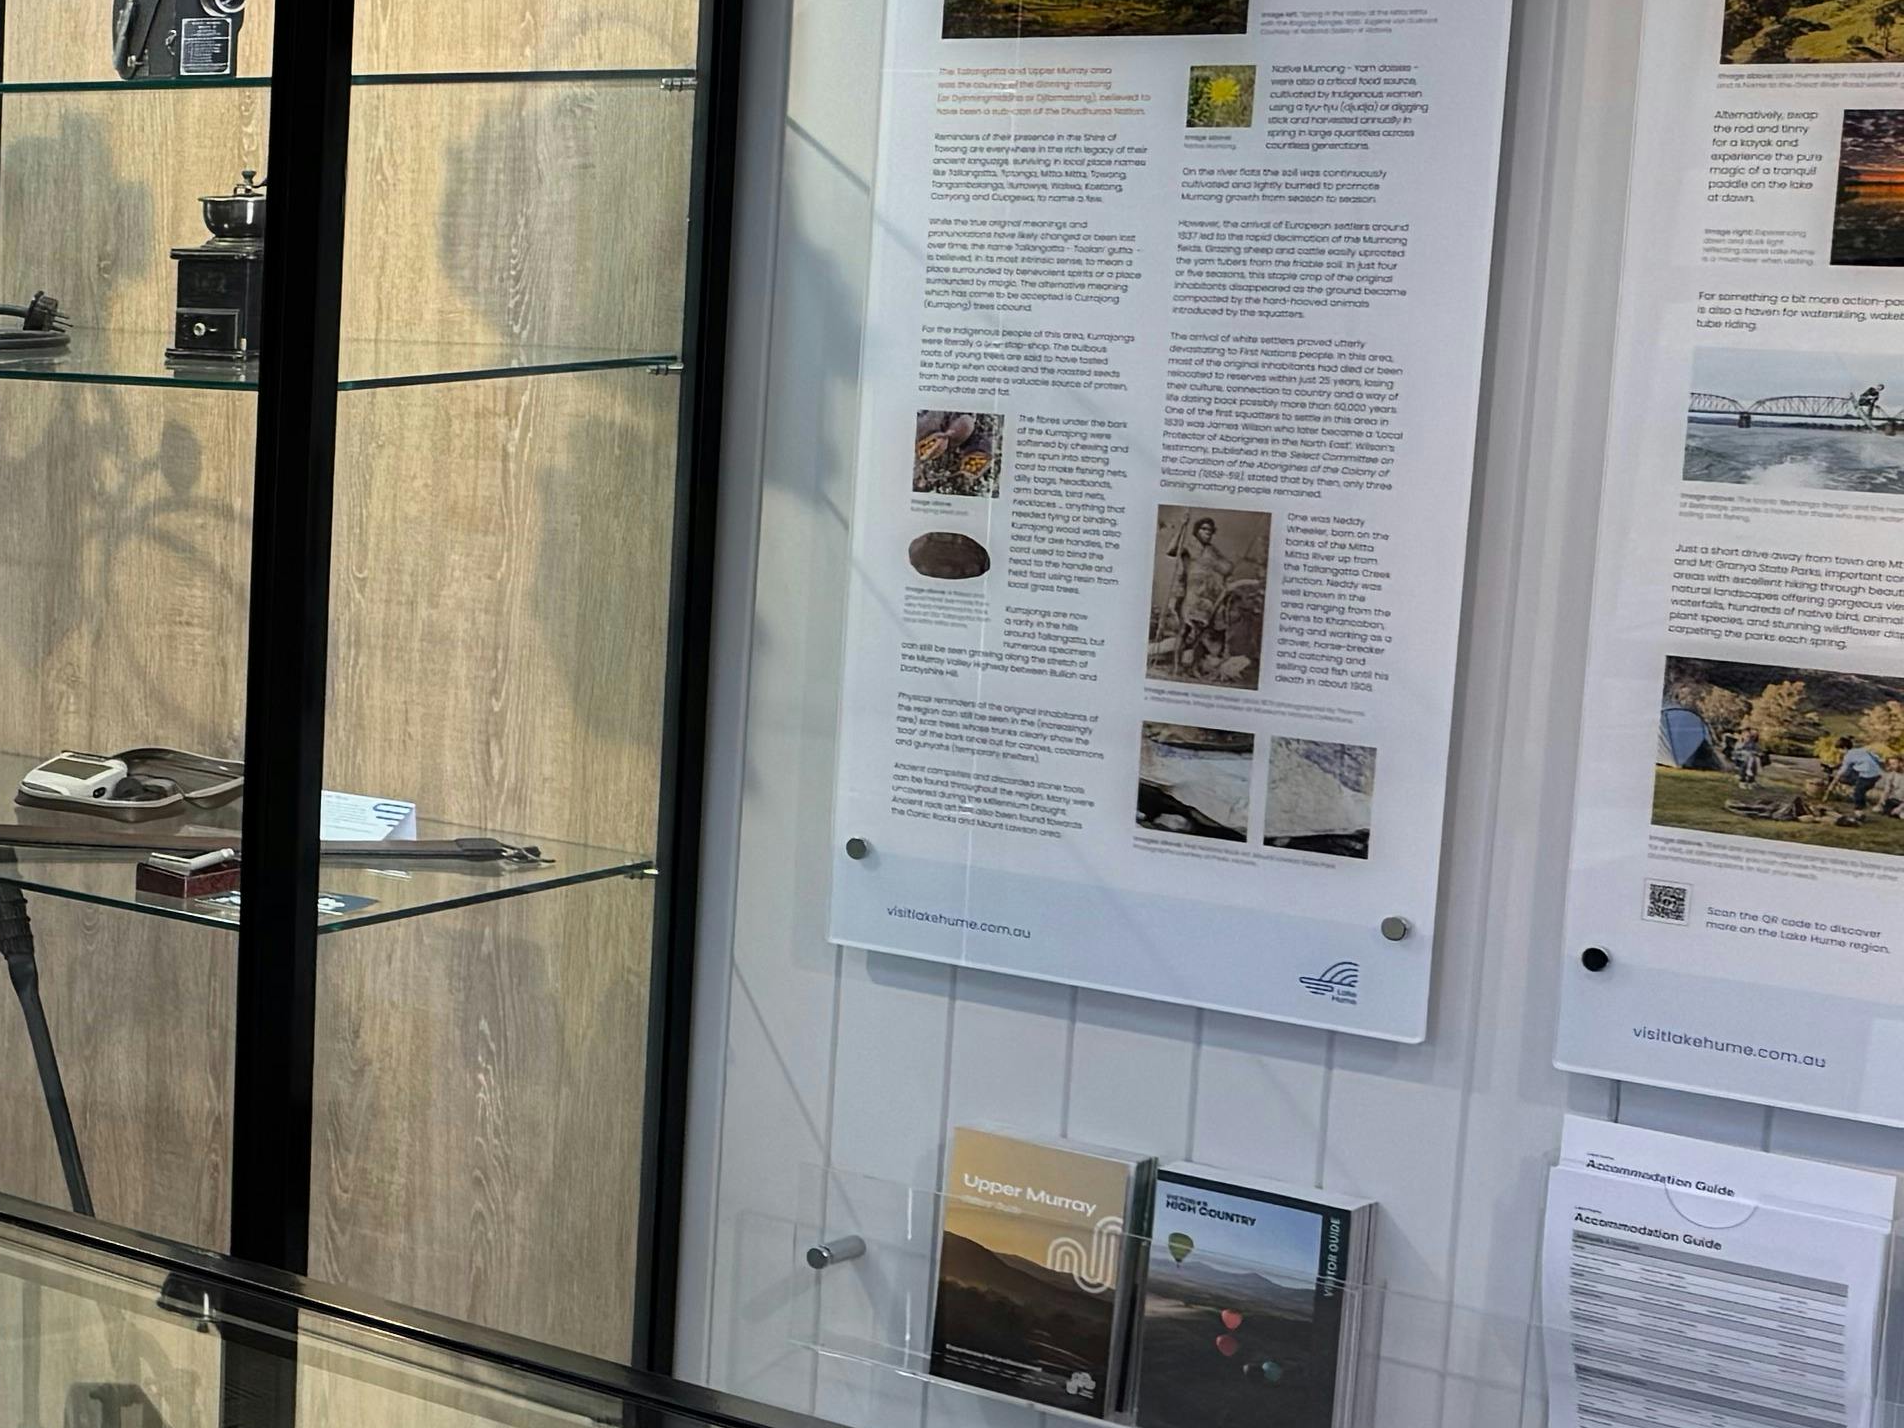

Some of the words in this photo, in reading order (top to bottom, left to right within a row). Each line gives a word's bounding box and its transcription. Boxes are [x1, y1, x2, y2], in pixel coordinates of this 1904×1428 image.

[1633, 1026, 1826, 1068] visitlakehume.com.au
[963, 1173, 1023, 1198] Upper
[1026, 1186, 1096, 1217] Murray
[1586, 1160, 1692, 1188] Accommodation
[1695, 1181, 1735, 1197] Guide
[1574, 1213, 1679, 1241] Accommodation
[1683, 1234, 1722, 1251] Guide
